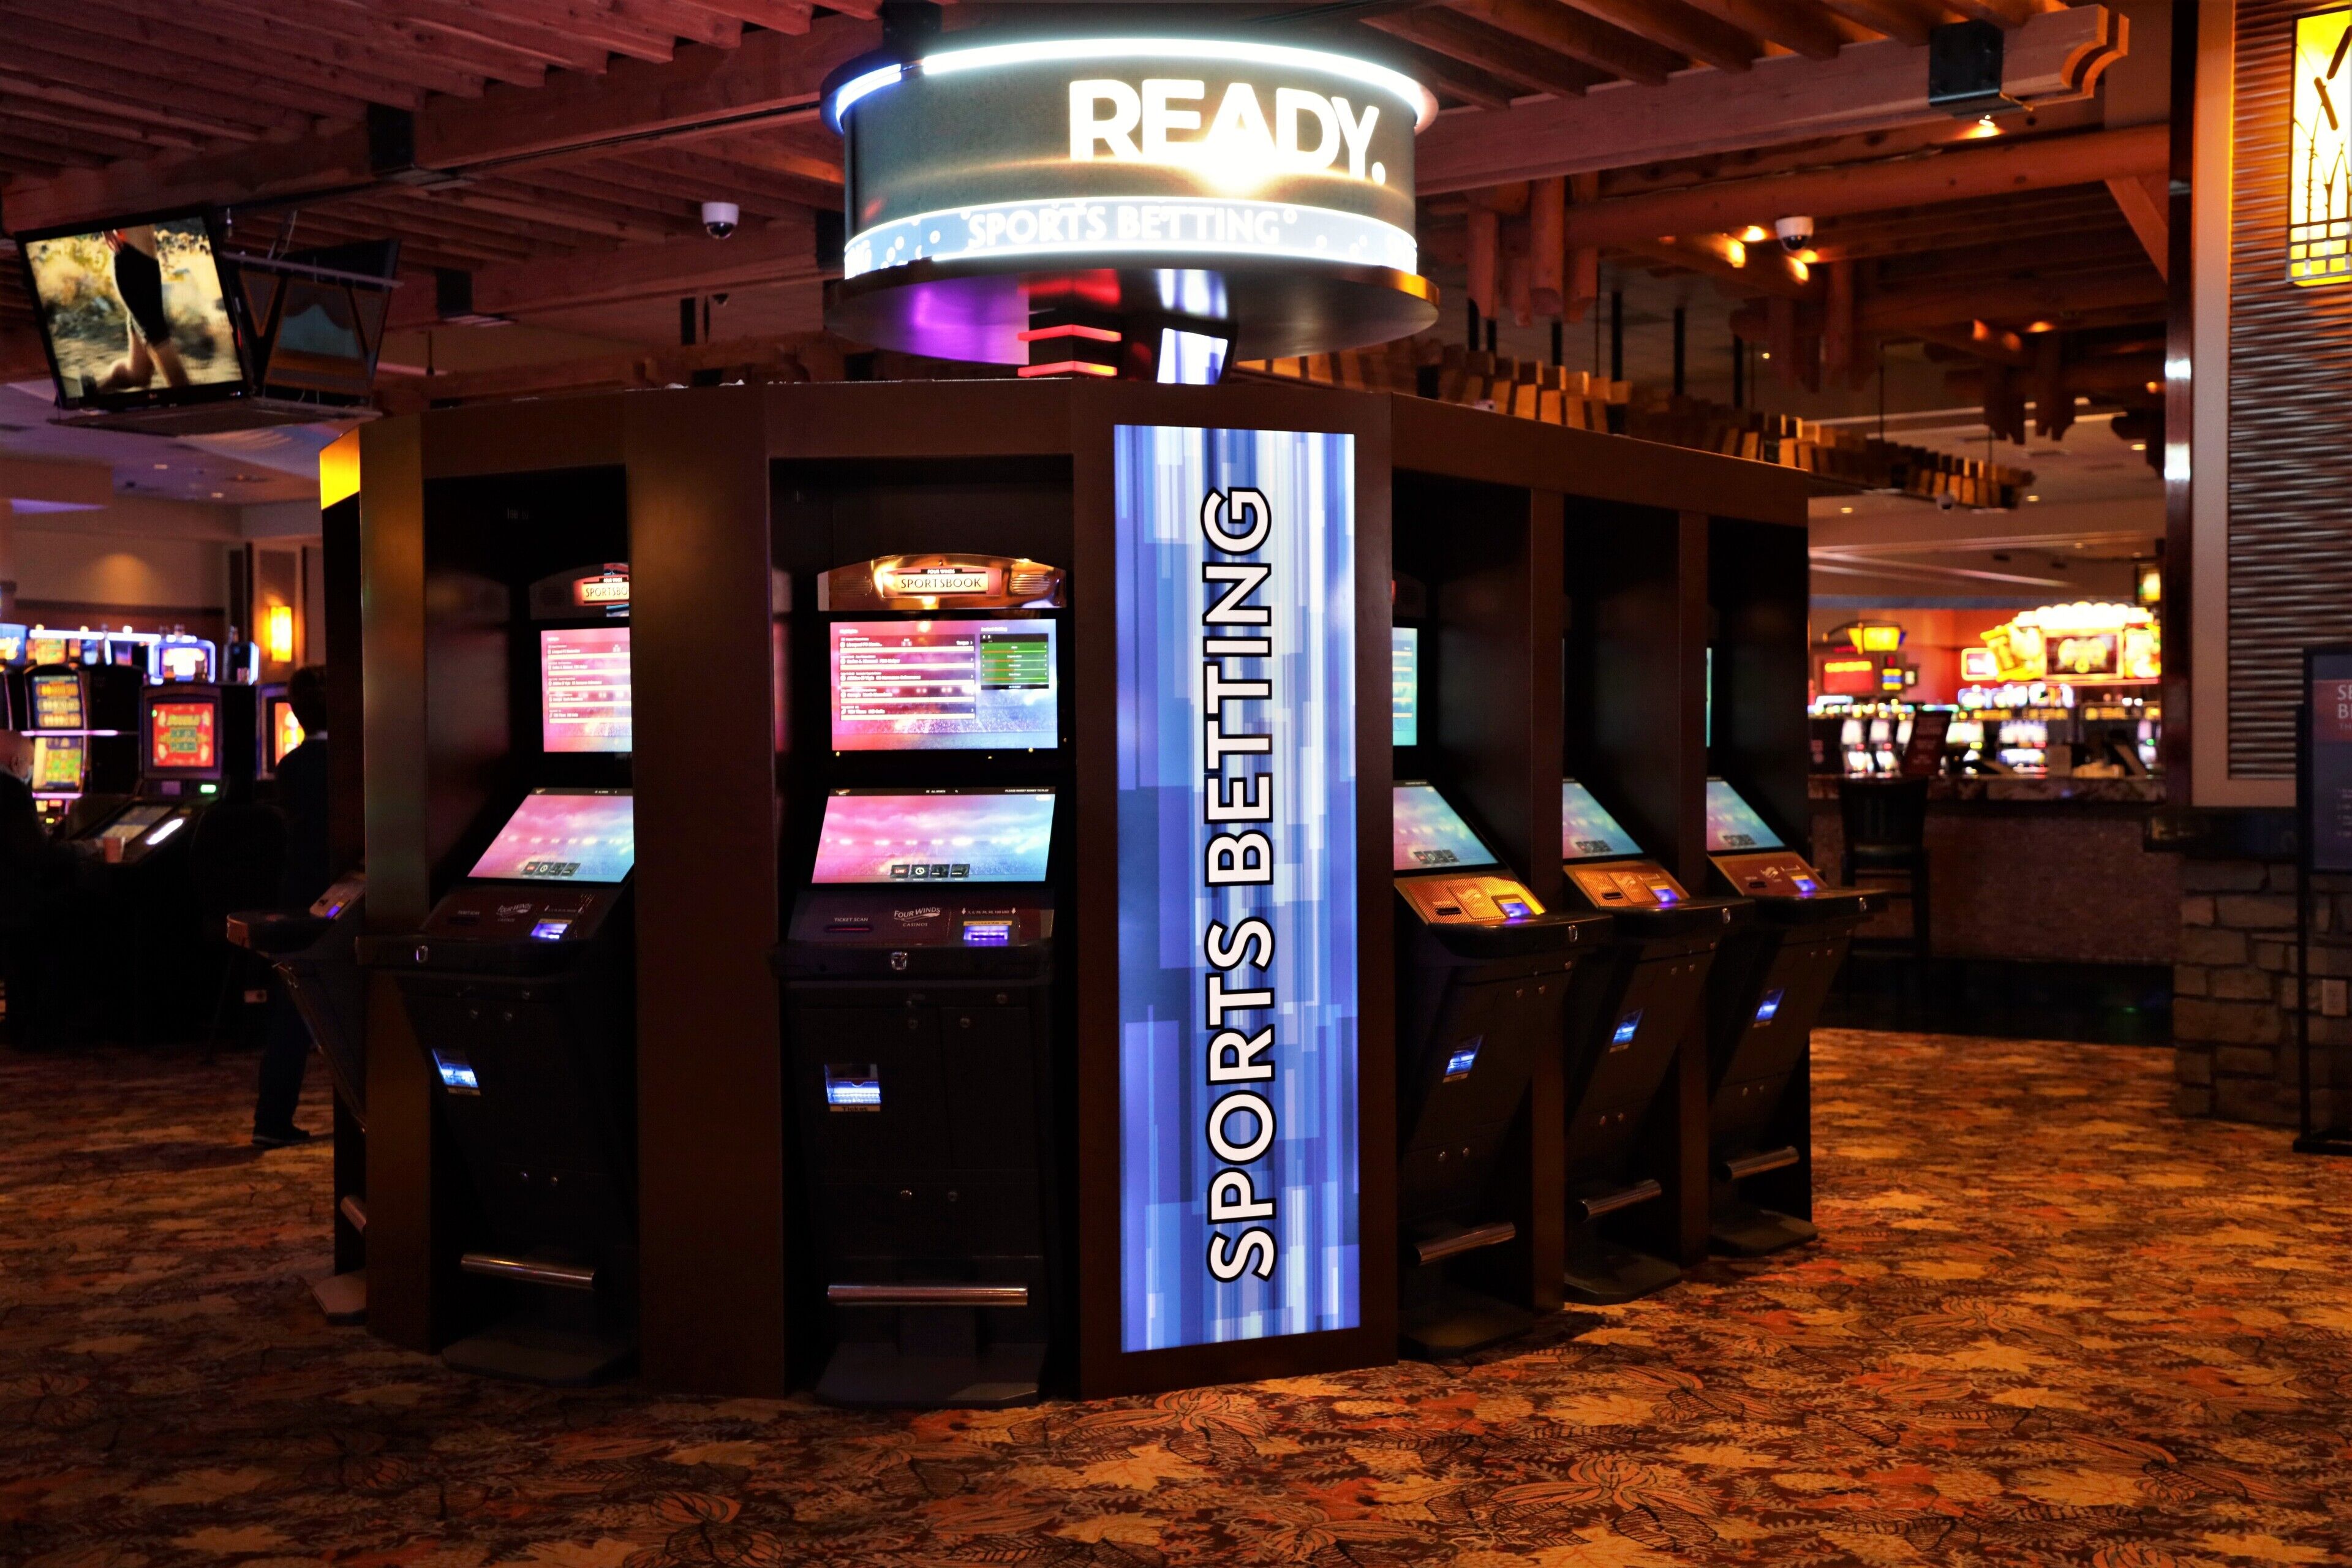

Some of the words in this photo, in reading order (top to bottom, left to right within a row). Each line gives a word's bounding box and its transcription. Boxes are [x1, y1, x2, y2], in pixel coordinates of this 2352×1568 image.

[1068, 78, 1387, 186] READY.
[968, 206, 1107, 248] SPORTS
[1117, 205, 1281, 246] BETTING
[586, 586, 628, 597] SPORTSBO
[901, 578, 981, 589] SPORTSBOOK
[1201, 486, 1274, 889] BETTING
[2338, 703, 2352, 719] B
[1205, 911, 1280, 1284] SPORTS
